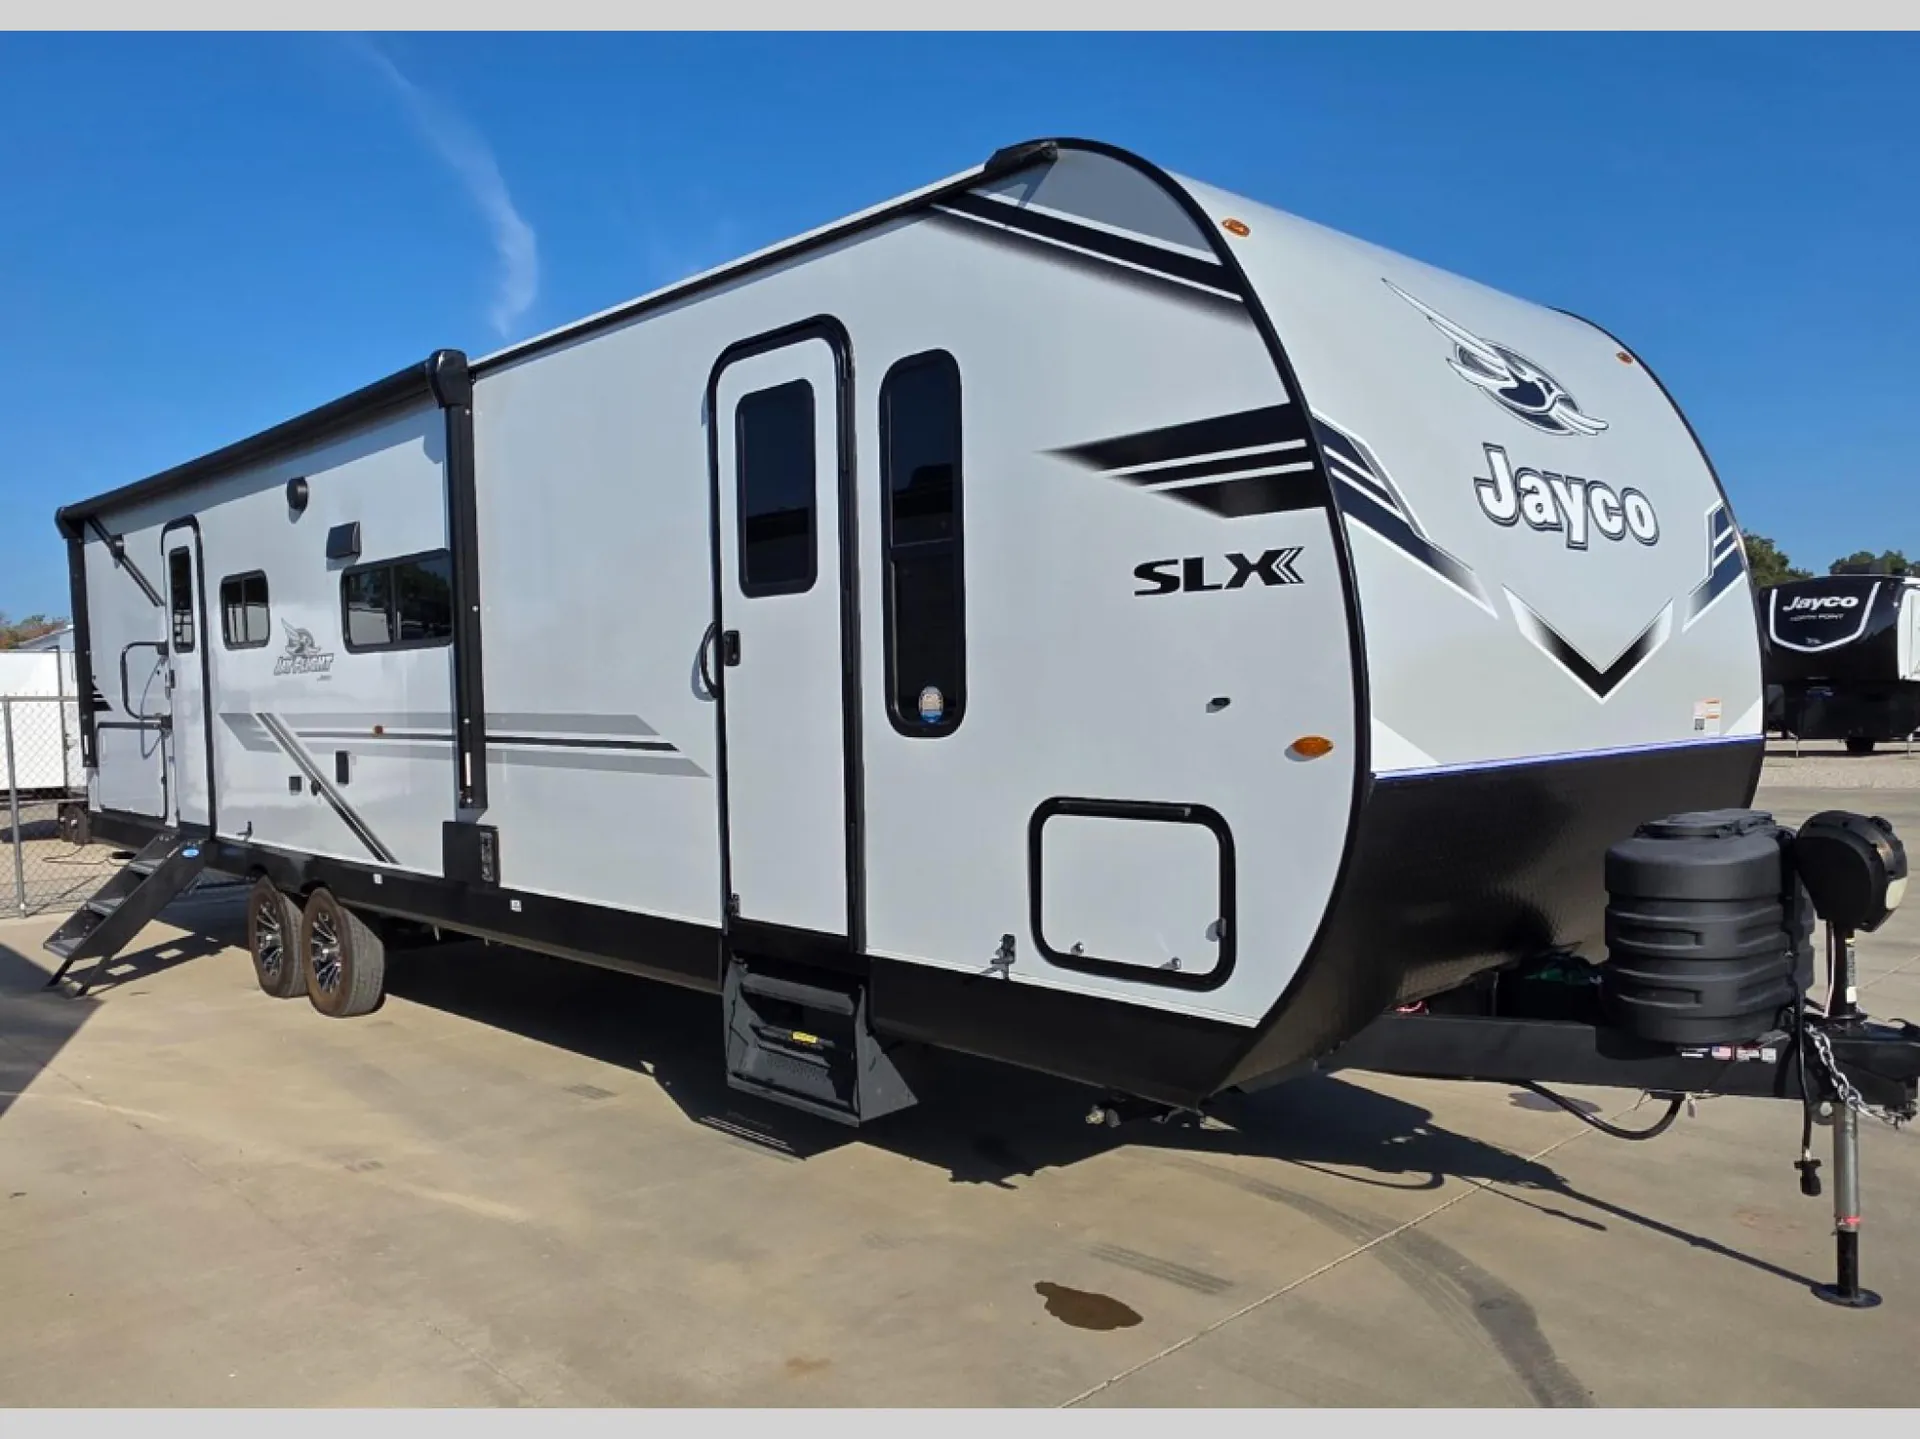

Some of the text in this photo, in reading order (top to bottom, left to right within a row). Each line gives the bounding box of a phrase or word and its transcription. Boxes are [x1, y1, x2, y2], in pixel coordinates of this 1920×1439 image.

[1473, 442, 1660, 550] Jayco
[1133, 546, 1305, 597] SLX
[1782, 596, 1859, 611] Jayco
